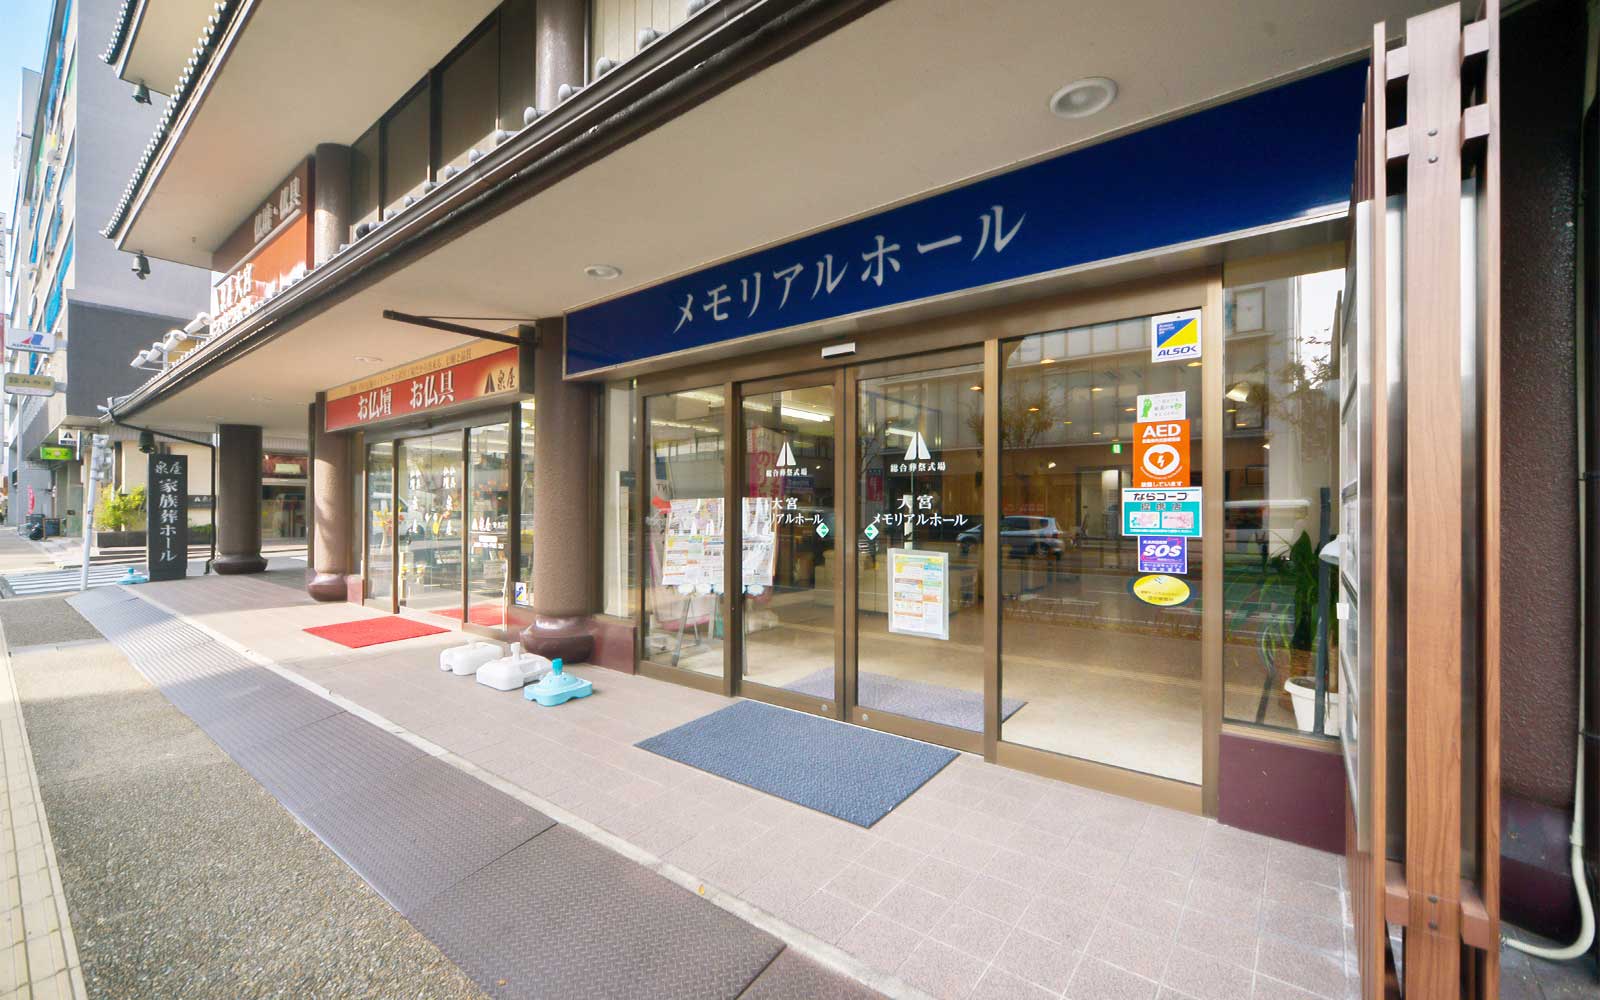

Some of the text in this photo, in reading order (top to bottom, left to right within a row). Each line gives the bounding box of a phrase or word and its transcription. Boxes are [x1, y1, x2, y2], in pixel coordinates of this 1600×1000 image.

[672, 204, 1027, 335] メモリアルホール
[1157, 345, 1198, 357] ALSOK
[356, 387, 393, 421] お仏壇
[408, 369, 456, 410] お仏具
[1142, 423, 1182, 438] AED
[889, 461, 946, 473] 総合葬祭式場
[771, 496, 799, 510] 大宮
[896, 494, 934, 510] 大宮
[158, 478, 178, 562] 家族葬ホール
[872, 512, 969, 527] メモリアルホール
[1143, 544, 1183, 558] SOS
